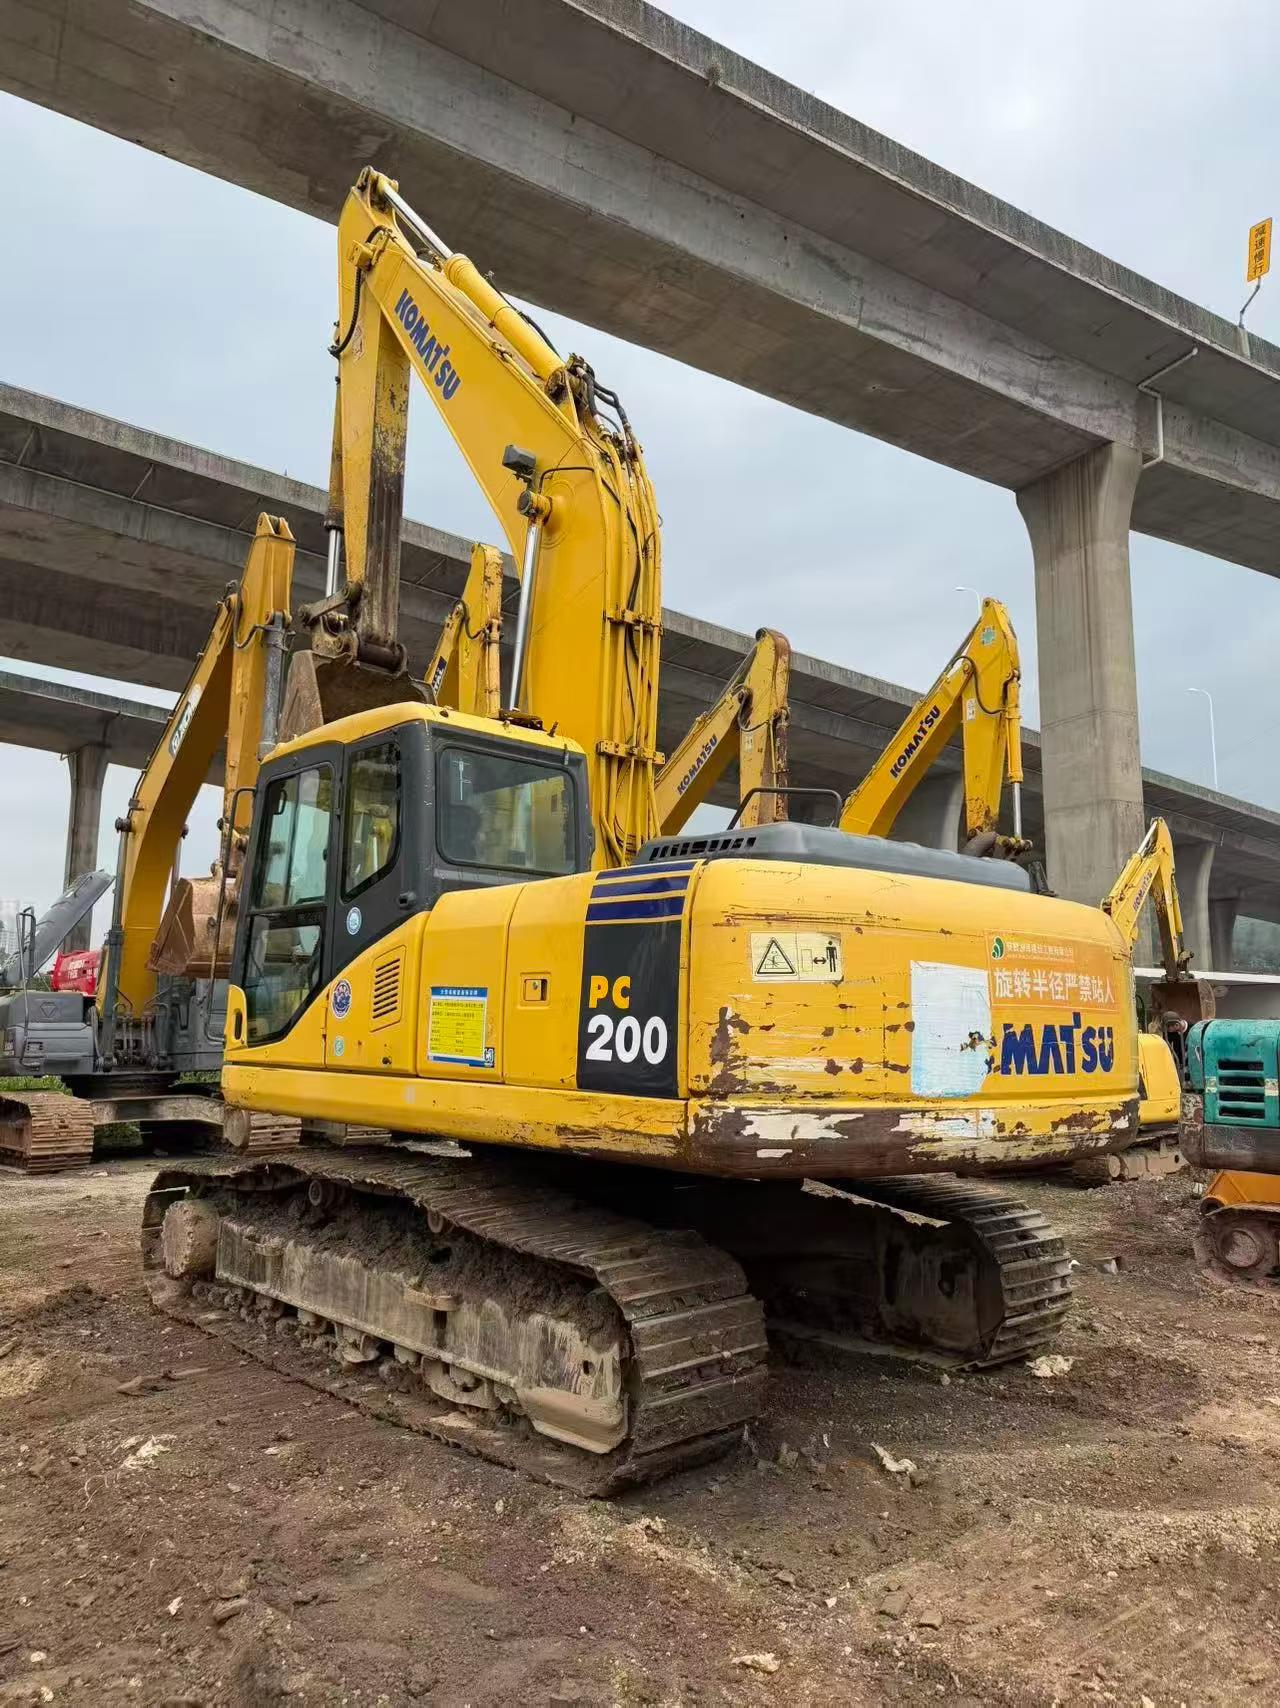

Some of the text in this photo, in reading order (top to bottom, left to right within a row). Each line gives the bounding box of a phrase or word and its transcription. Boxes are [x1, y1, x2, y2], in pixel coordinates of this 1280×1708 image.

[394, 287, 461, 400] KOMATSU
[677, 733, 718, 795] KOMATSU
[889, 705, 940, 778] KOMATSU
[588, 975, 631, 1009] PC
[993, 967, 1115, 1003] 旋转半径严禁站人
[585, 1014, 668, 1065] 200
[1000, 1012, 1114, 1075] MATSU
